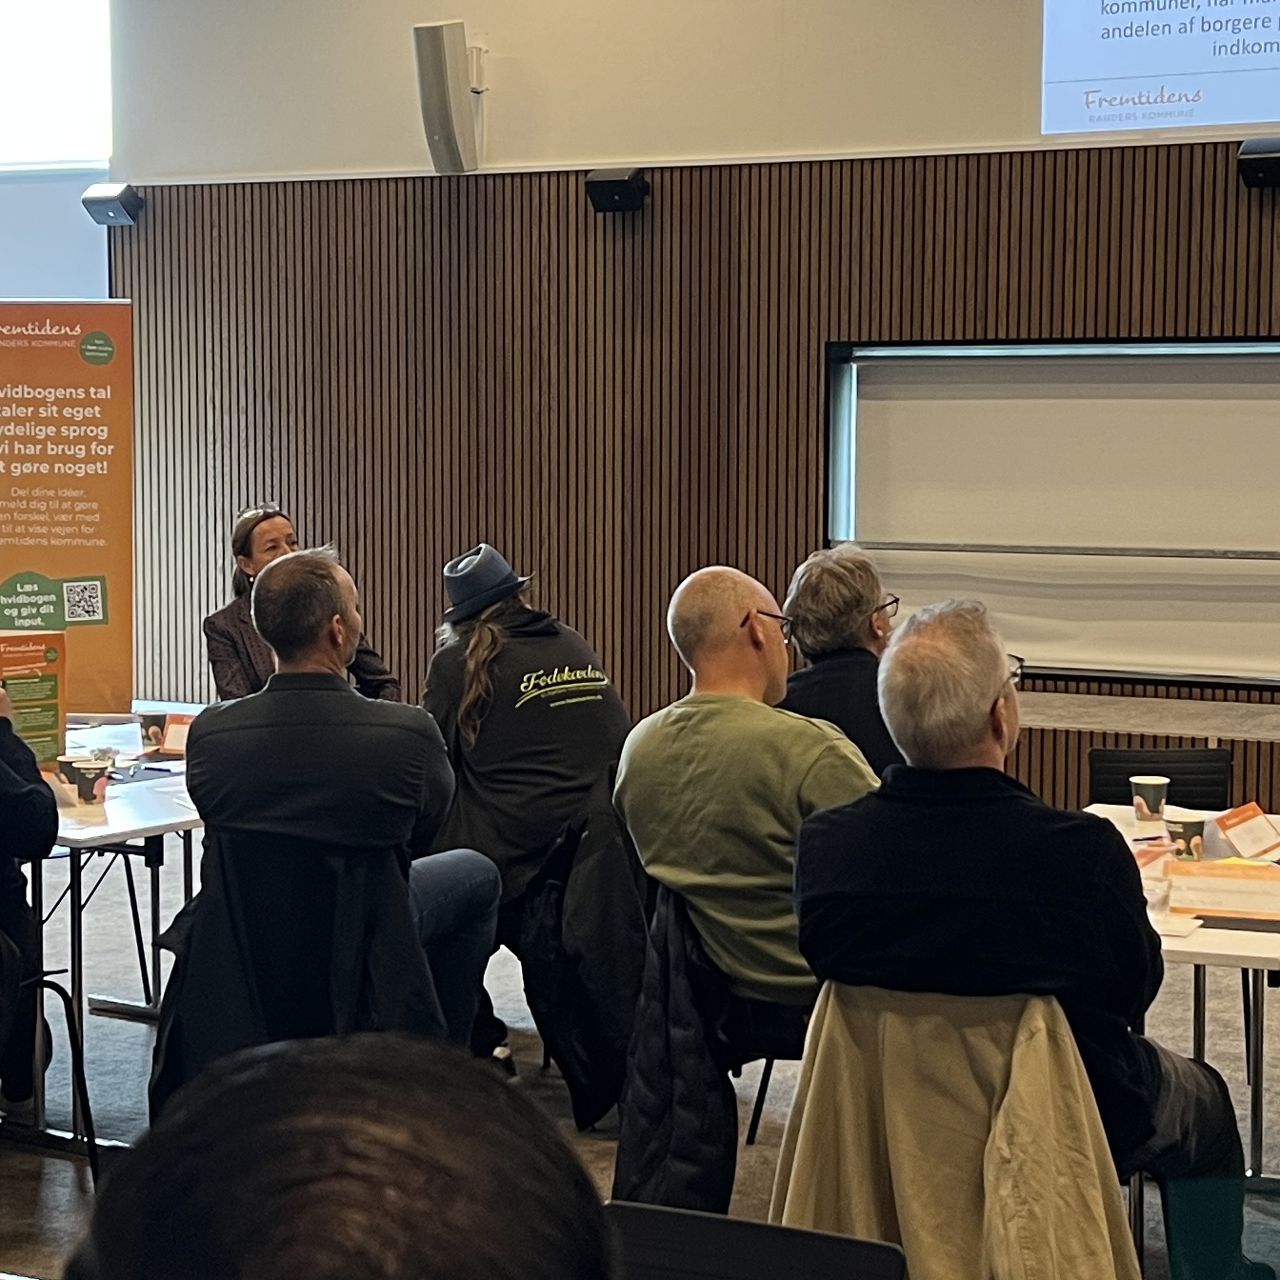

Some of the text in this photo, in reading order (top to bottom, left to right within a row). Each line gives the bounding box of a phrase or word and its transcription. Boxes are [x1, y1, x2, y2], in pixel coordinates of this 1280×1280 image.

[1100, 0, 1200, 15] kommuner,
[1101, 20, 1171, 39] andelen
[1178, 16, 1196, 34] af
[1201, 15, 1272, 34] borgere
[1083, 85, 1201, 109] Fremtidens
[1089, 108, 1194, 123] RANDERS KOMMUNE
[31, 340, 77, 348] KOMMUNE
[89, 385, 111, 399] tal
[38, 404, 58, 417] sit
[63, 405, 101, 420] eget
[61, 426, 108, 440] sprog
[14, 441, 42, 455] har
[47, 441, 86, 458] brug
[90, 442, 114, 455] for
[10, 462, 49, 476] gøre
[54, 461, 108, 476] noget!
[11, 487, 29, 497] Del
[31, 487, 54, 497] dine
[29, 500, 47, 511] dig
[49, 500, 59, 509] til
[61, 501, 72, 509] at
[14, 512, 50, 521] forskel,
[53, 513, 73, 521] vær
[75, 512, 100, 521] med
[2, 524, 95, 535] til at vise vejen for
[50, 537, 107, 546] kommune.
[17, 583, 38, 592] Læs
[0, 594, 56, 604] hvidbogen
[4, 605, 54, 617] og giv dit
[15, 618, 45, 627] input.
